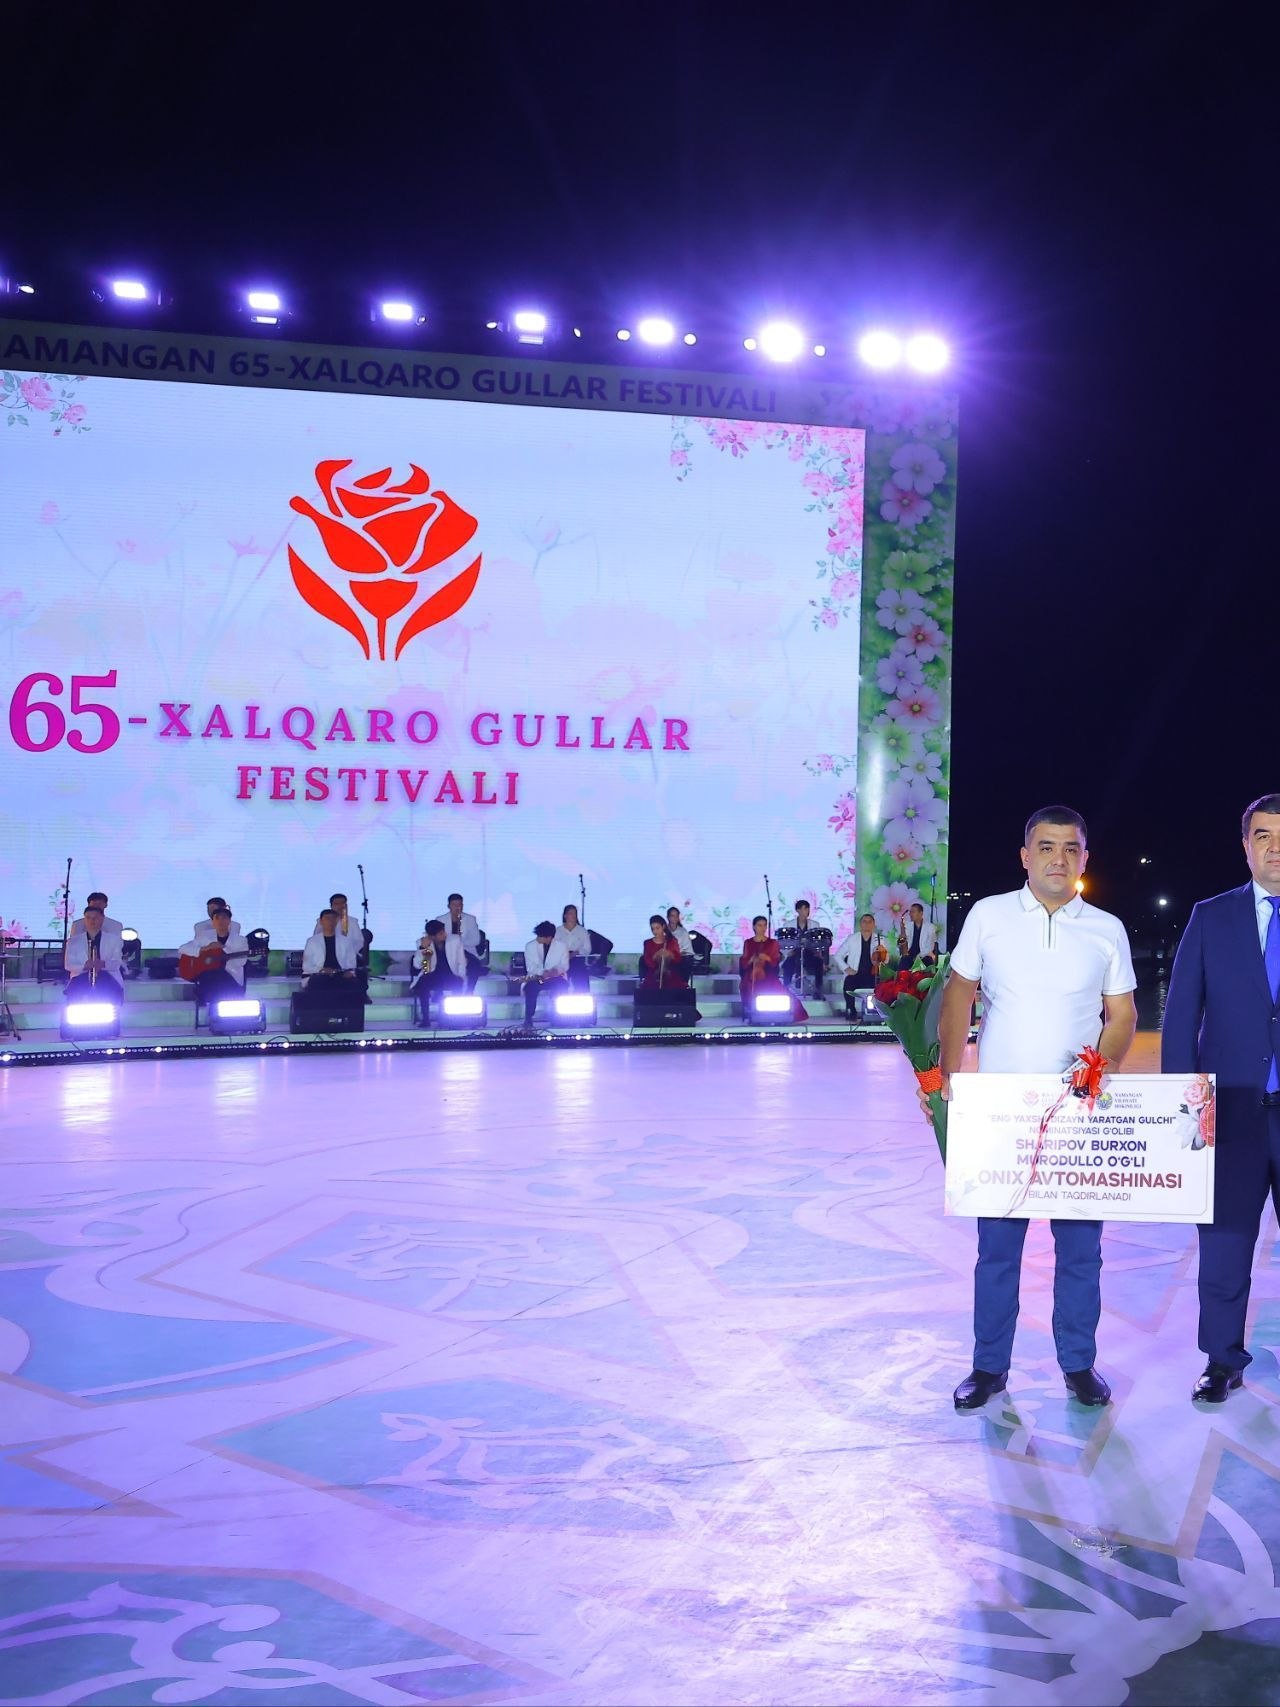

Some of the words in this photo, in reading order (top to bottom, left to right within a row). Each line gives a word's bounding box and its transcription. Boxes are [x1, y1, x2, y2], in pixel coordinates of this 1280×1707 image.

[3, 334, 216, 375] AMANGAN
[229, 352, 460, 390] 65-XALQARO
[472, 369, 608, 400] GULLAR
[619, 379, 776, 413] FESTIVALI
[9, 669, 439, 755] 65-XALQARO
[471, 712, 690, 750] GULLAR
[236, 765, 519, 805] FESTIVALI
[1088, 1116, 1136, 1124] YARATGAN
[1138, 1116, 1177, 1125] GULCHI"
[1091, 1140, 1147, 1152] BURXON
[978, 1170, 1024, 1185] ONIX
[1030, 1171, 1182, 1189] AVTOMASHINASI
[1029, 1190, 1058, 1200] BILAN
[1061, 1191, 1131, 1201] TAQDIRLANADI
